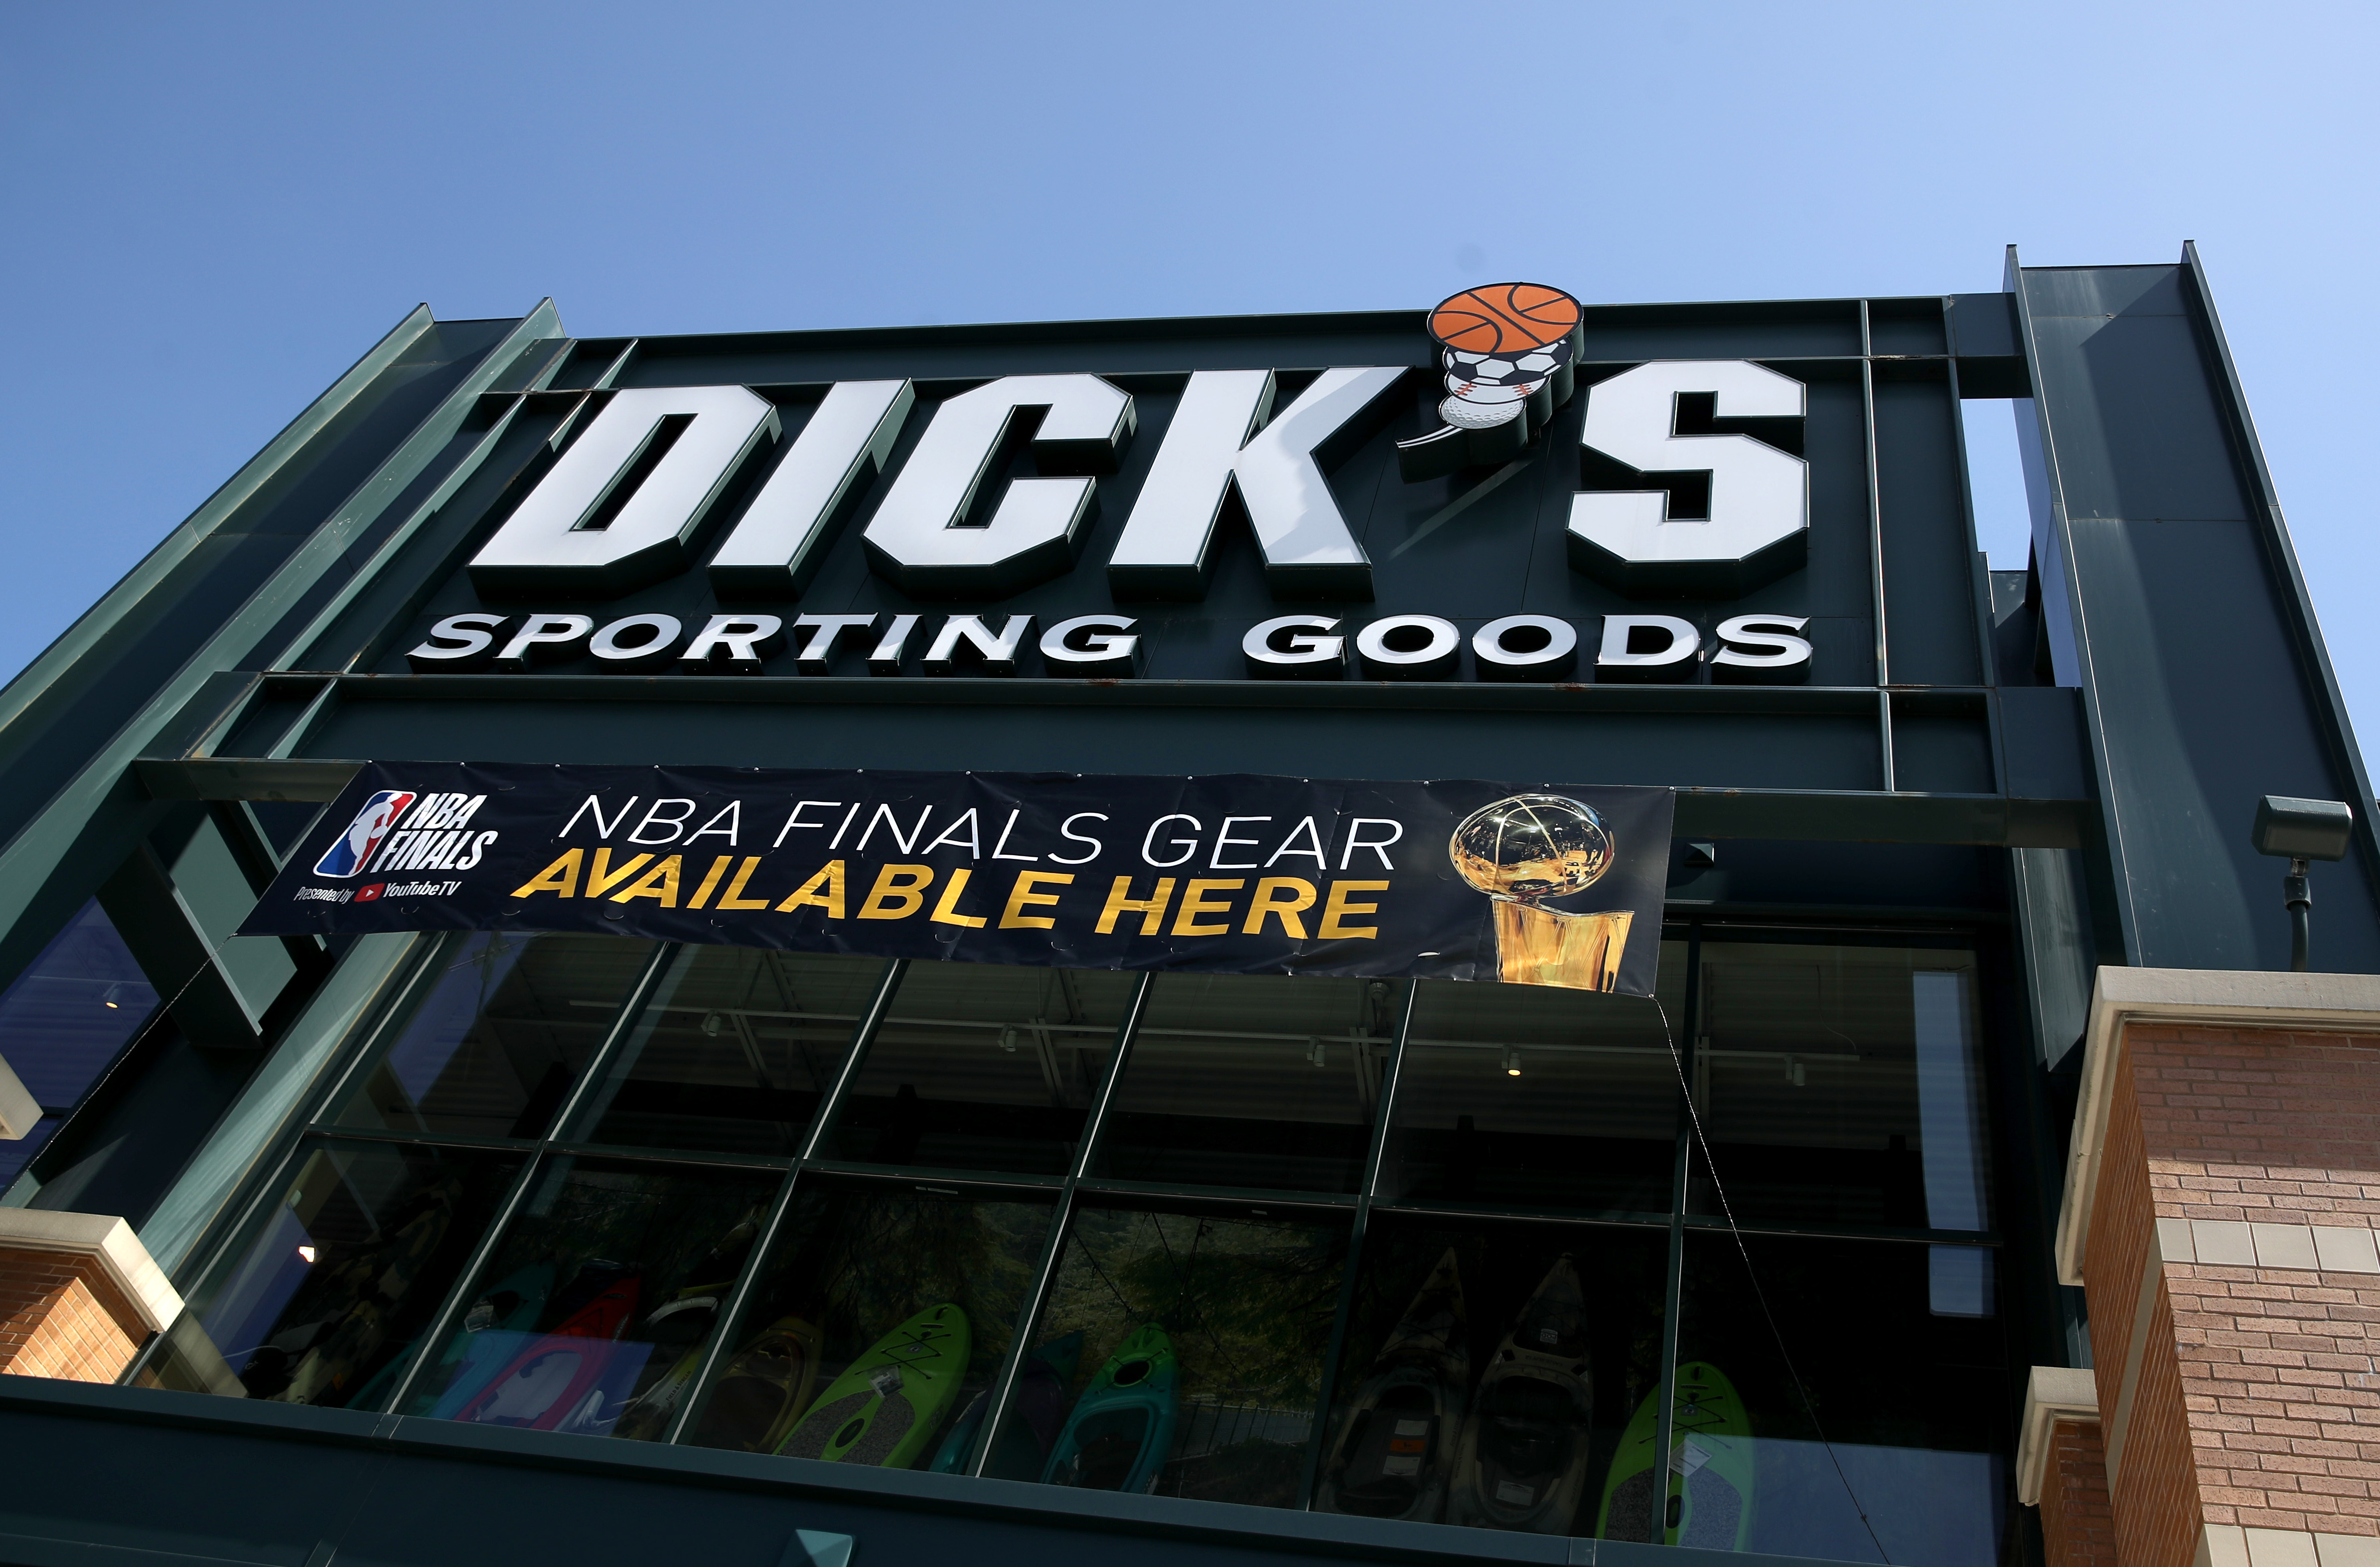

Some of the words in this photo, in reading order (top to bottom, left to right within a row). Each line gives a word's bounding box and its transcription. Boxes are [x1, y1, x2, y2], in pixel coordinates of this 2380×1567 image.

[466, 281, 1810, 569] DICK'S
[405, 614, 1142, 662] SPORTING
[1242, 614, 1813, 666] GOODS
[400, 793, 488, 829] NBA
[559, 794, 741, 846] NBA
[773, 800, 1109, 865] FINALS
[1141, 813, 1403, 871] GEAR
[369, 830, 499, 873] FINALS
[293, 886, 345, 902] Presented
[338, 888, 355, 905] by
[510, 847, 1075, 930] AVAILABLE
[1094, 875, 1390, 940] HERE
